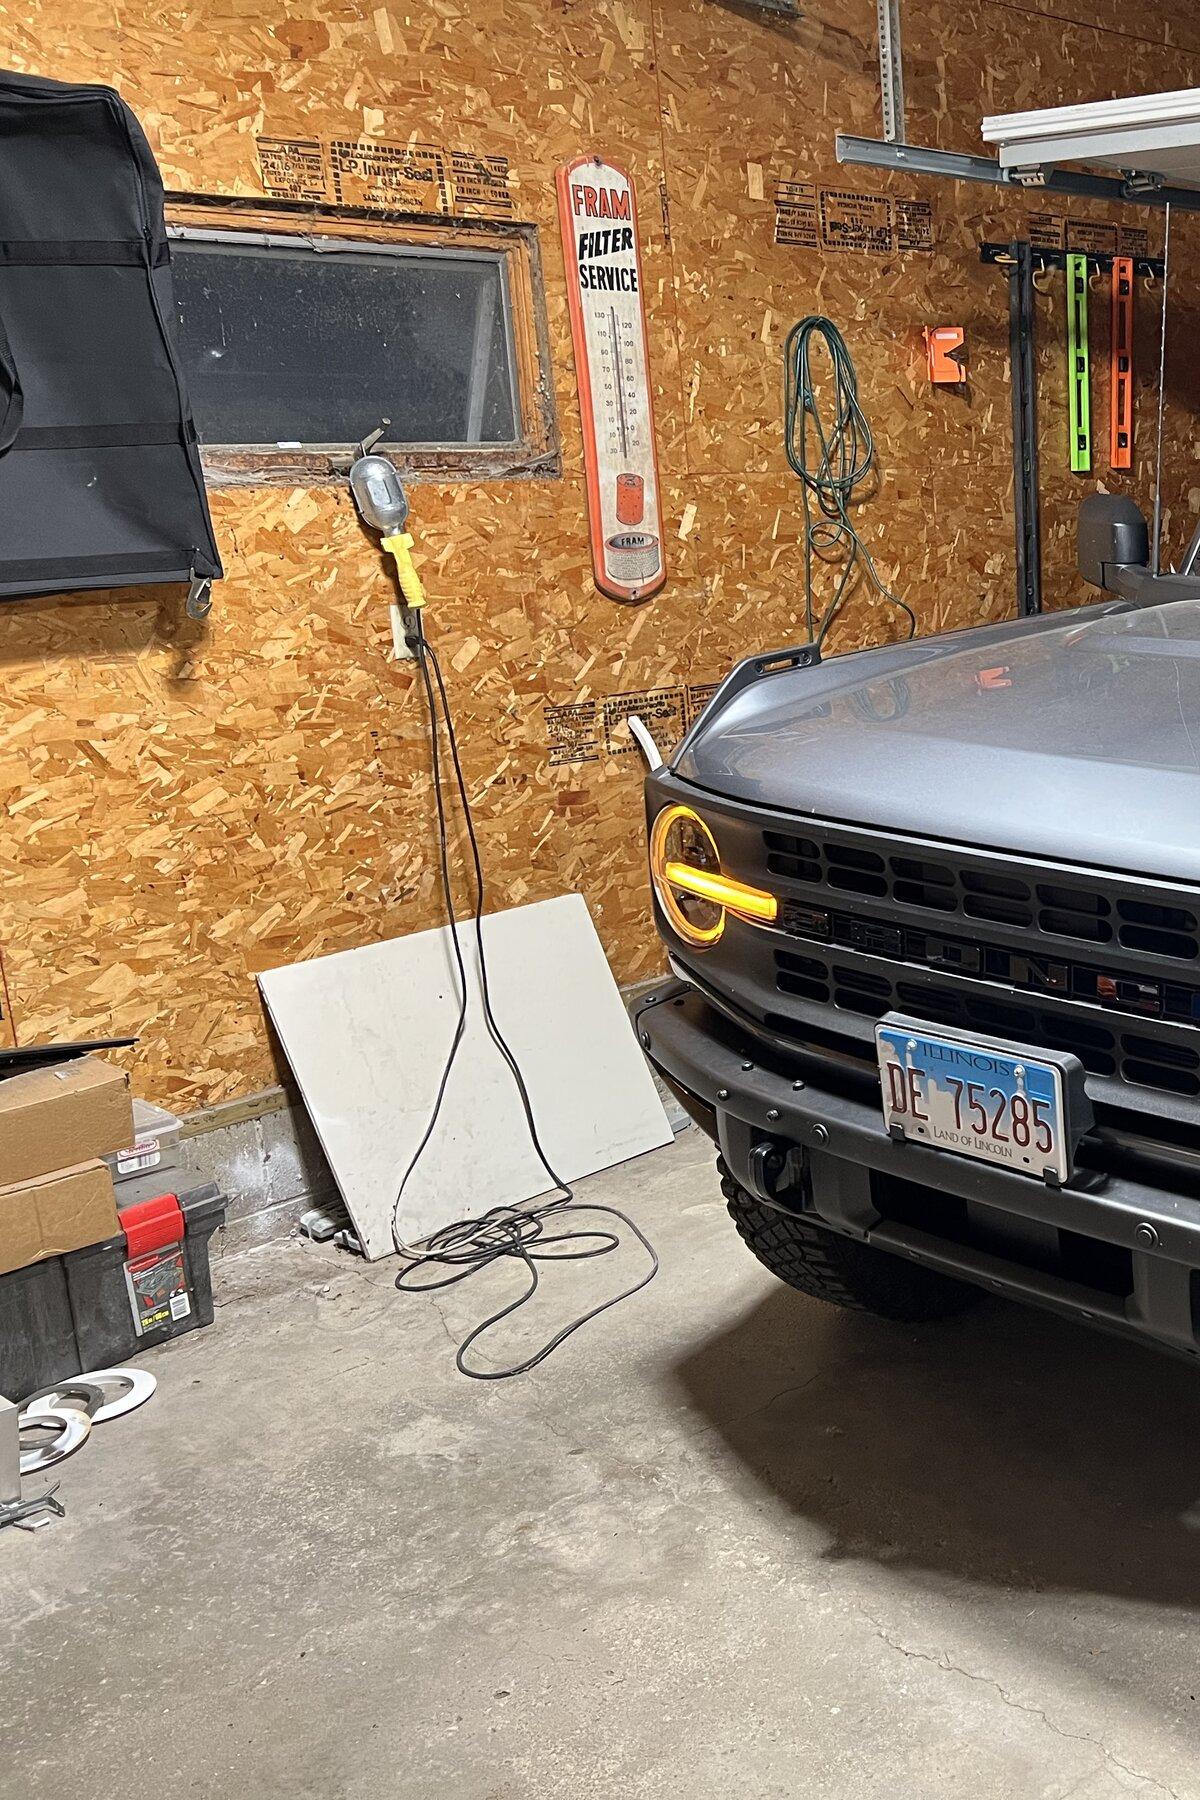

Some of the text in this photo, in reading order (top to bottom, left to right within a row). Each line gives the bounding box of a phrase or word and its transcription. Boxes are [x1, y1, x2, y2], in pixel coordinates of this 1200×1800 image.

[572, 184, 631, 220] FRAM
[579, 227, 633, 260] FILTER
[579, 263, 638, 292] SERVICE
[621, 537, 645, 547] FRAM
[923, 1043, 1010, 1077] ILLINOIS
[886, 1062, 1053, 1154] DE 75285
[933, 1125, 1013, 1158] LAND OF LINCOLN
